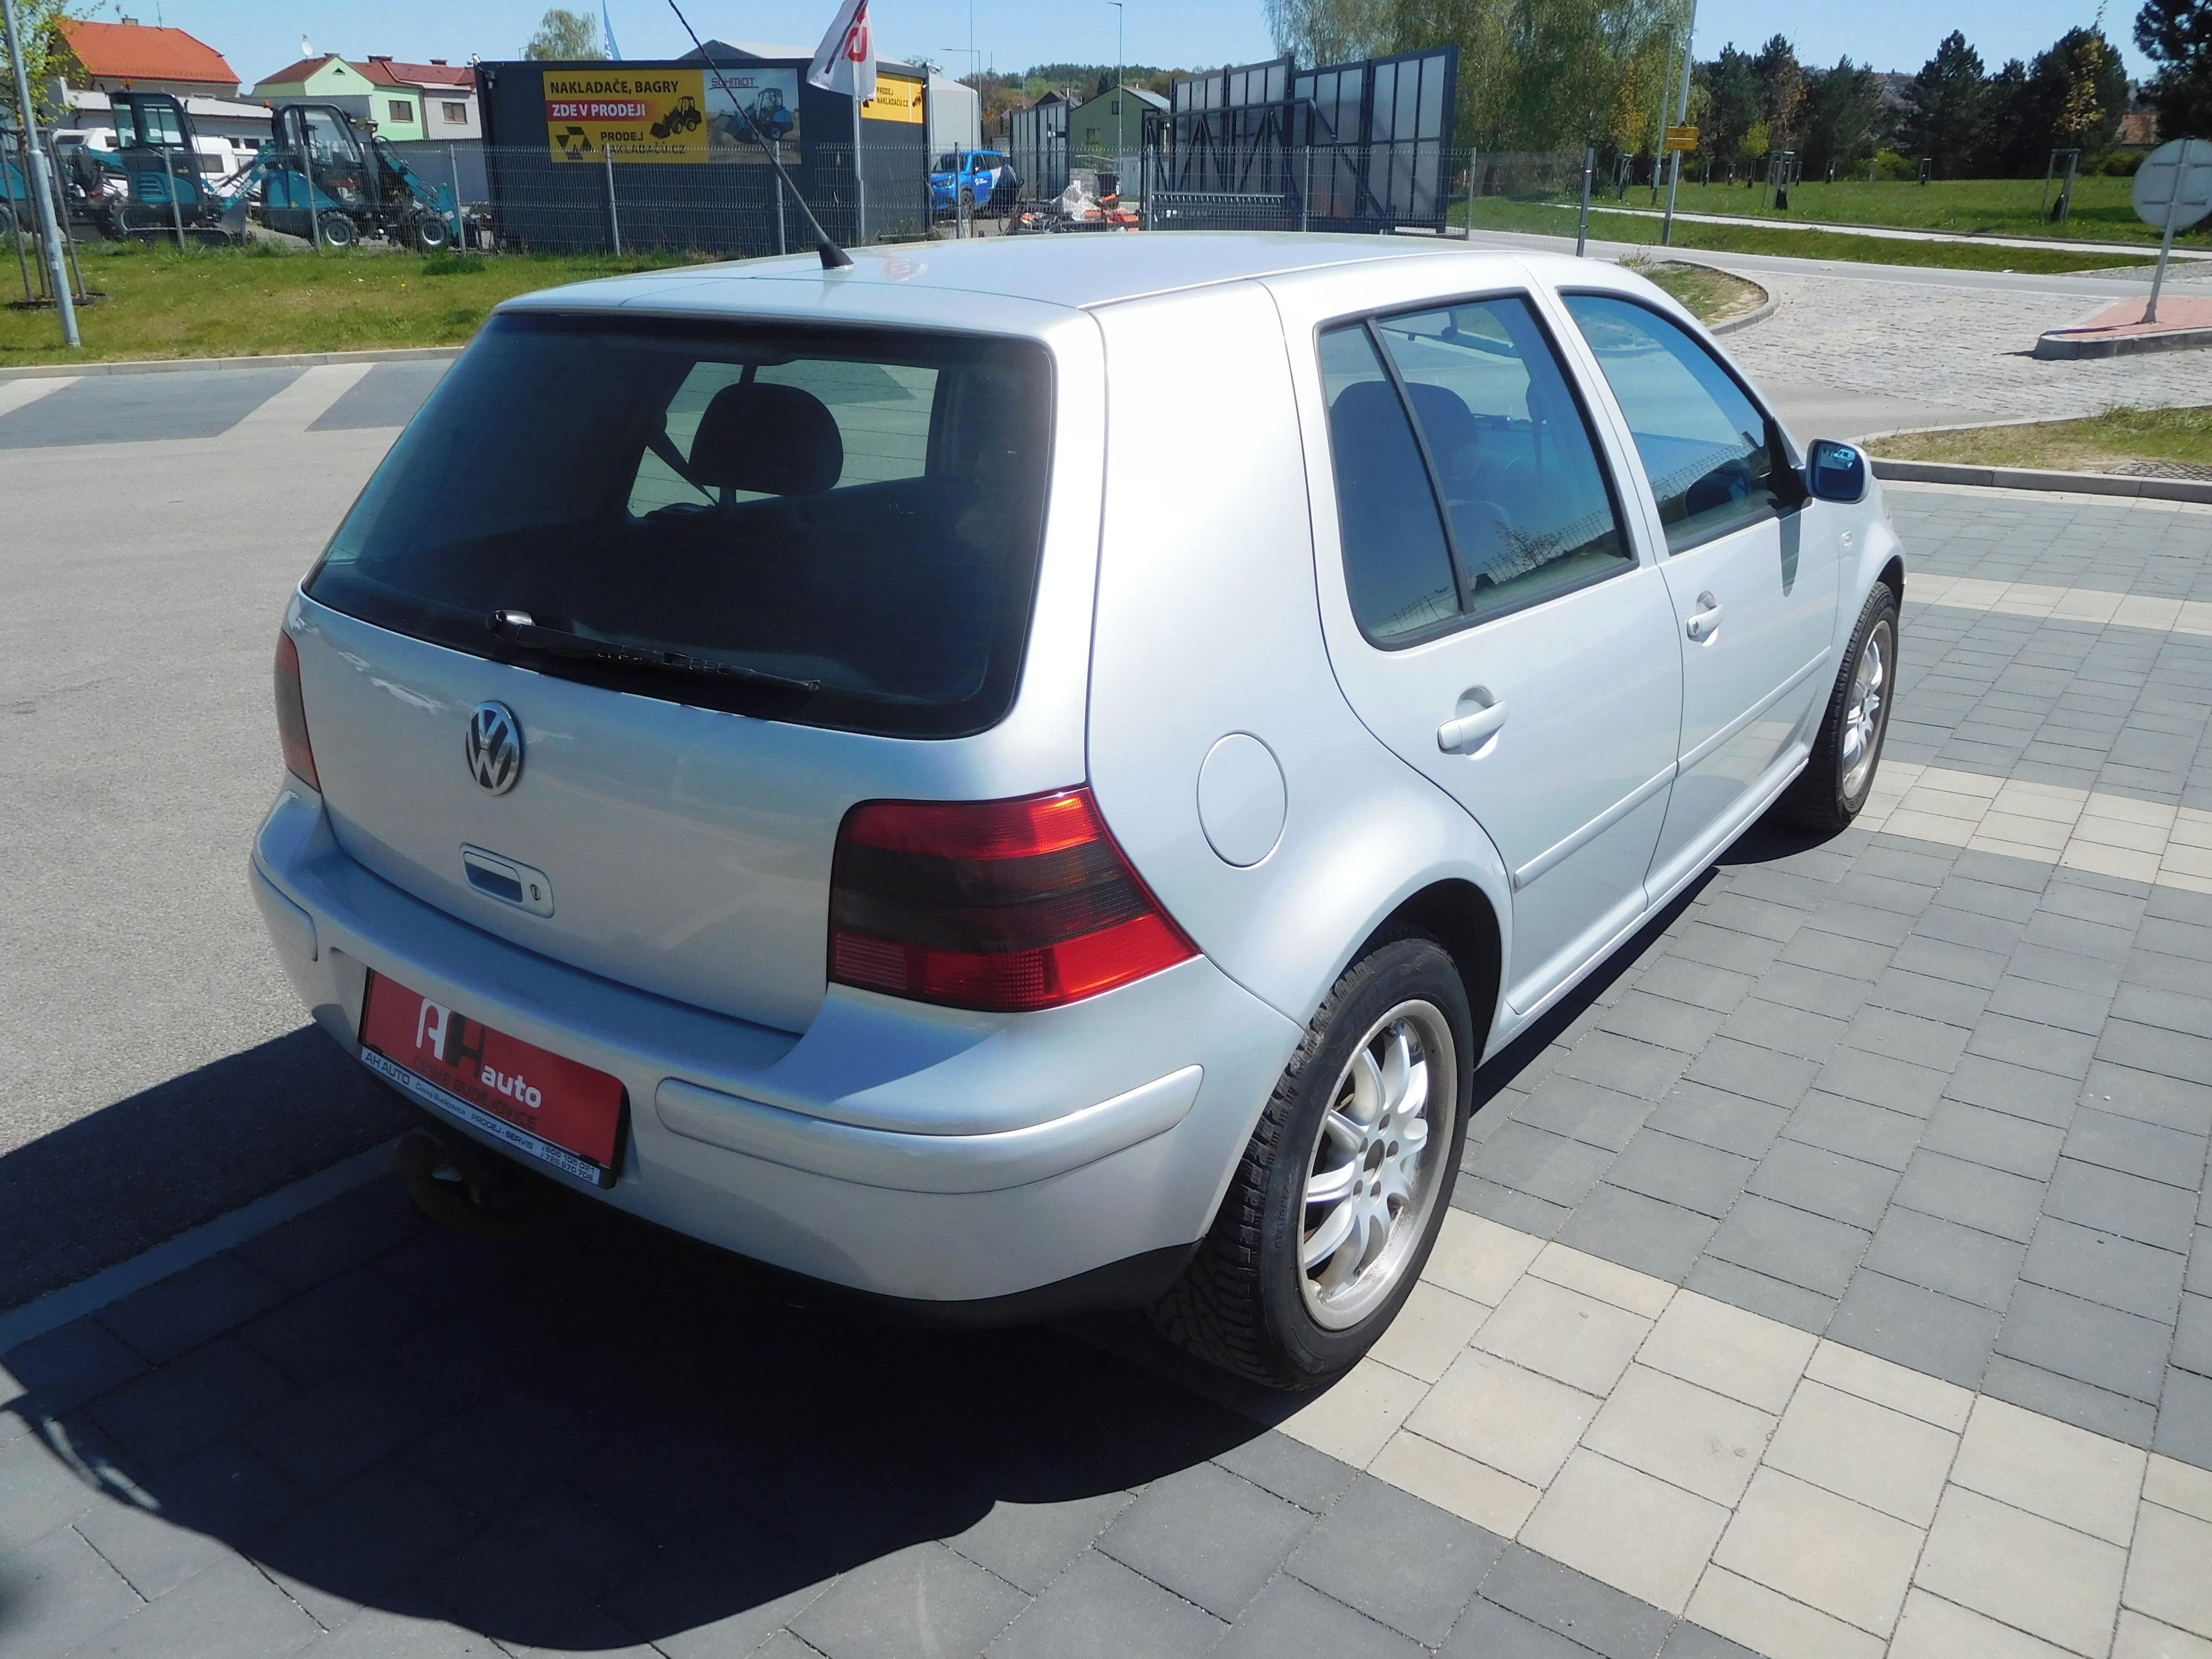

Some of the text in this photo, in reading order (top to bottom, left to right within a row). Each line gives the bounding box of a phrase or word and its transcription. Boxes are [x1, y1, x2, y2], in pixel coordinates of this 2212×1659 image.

[550, 78, 679, 95] NAKLADAČE, BAGRY
[876, 86, 893, 95] PRODEJ
[552, 104, 645, 117] ZDE V PRODEJI
[601, 131, 644, 141] PRODEJ
[365, 1053, 380, 1068] AH
[381, 1062, 410, 1085] AUTO
[481, 1064, 542, 1108] auto
[545, 1153, 561, 1165] 725
[564, 1155, 578, 1166] 105
[579, 1162, 595, 1174] 021
